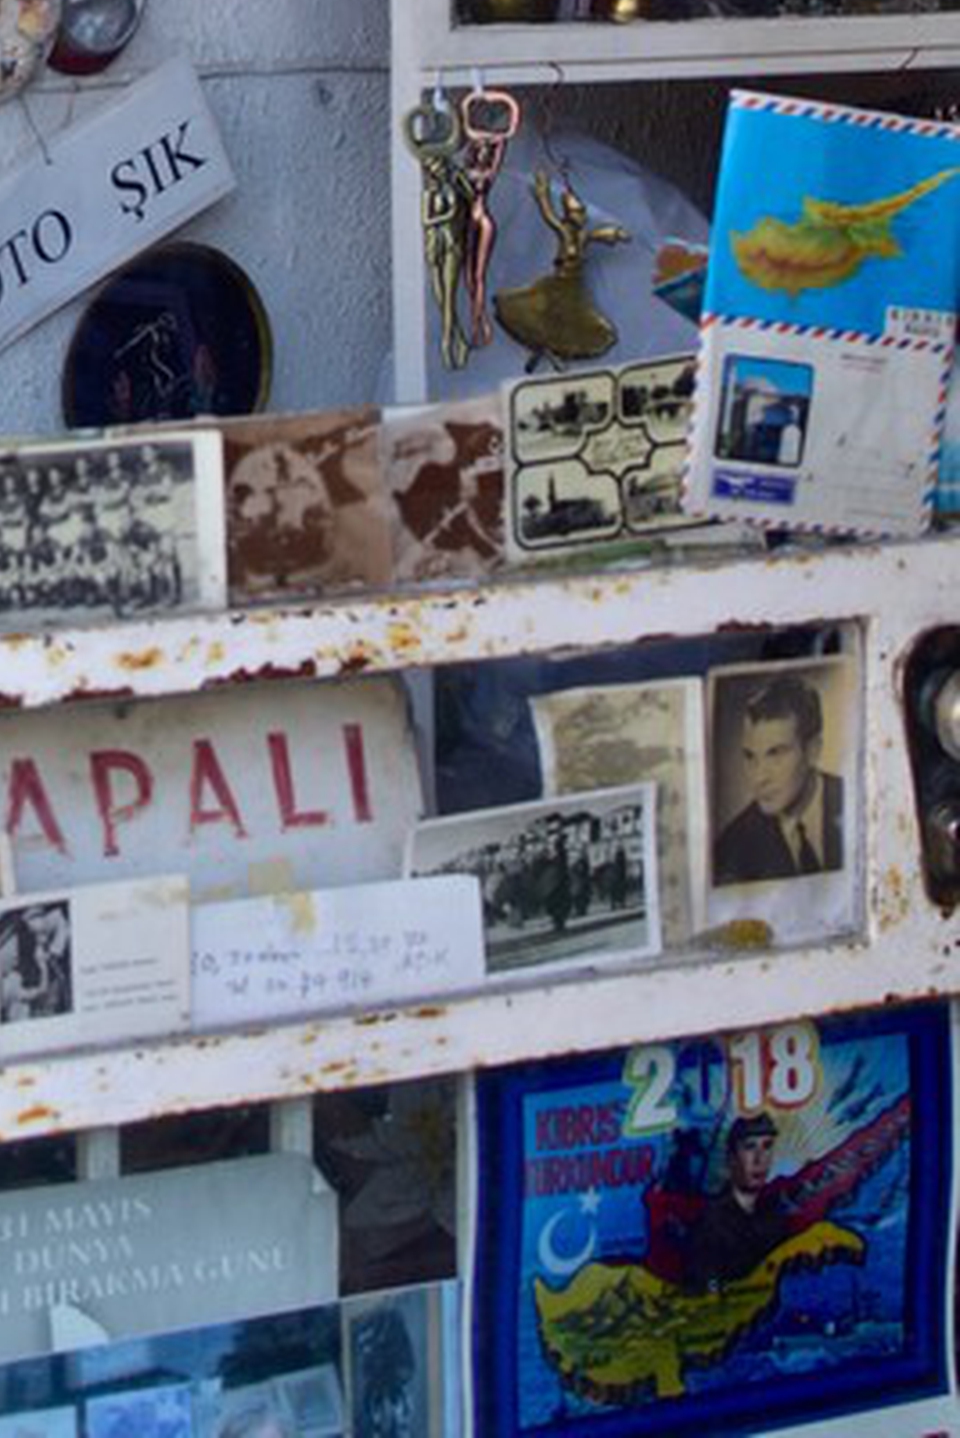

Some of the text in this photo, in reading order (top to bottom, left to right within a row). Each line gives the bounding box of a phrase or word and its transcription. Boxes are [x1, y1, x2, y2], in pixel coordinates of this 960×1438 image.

[109, 121, 207, 224] ŞIK
[622, 1019, 823, 1134] 2018
[44, 1196, 152, 1235] MAYIS
